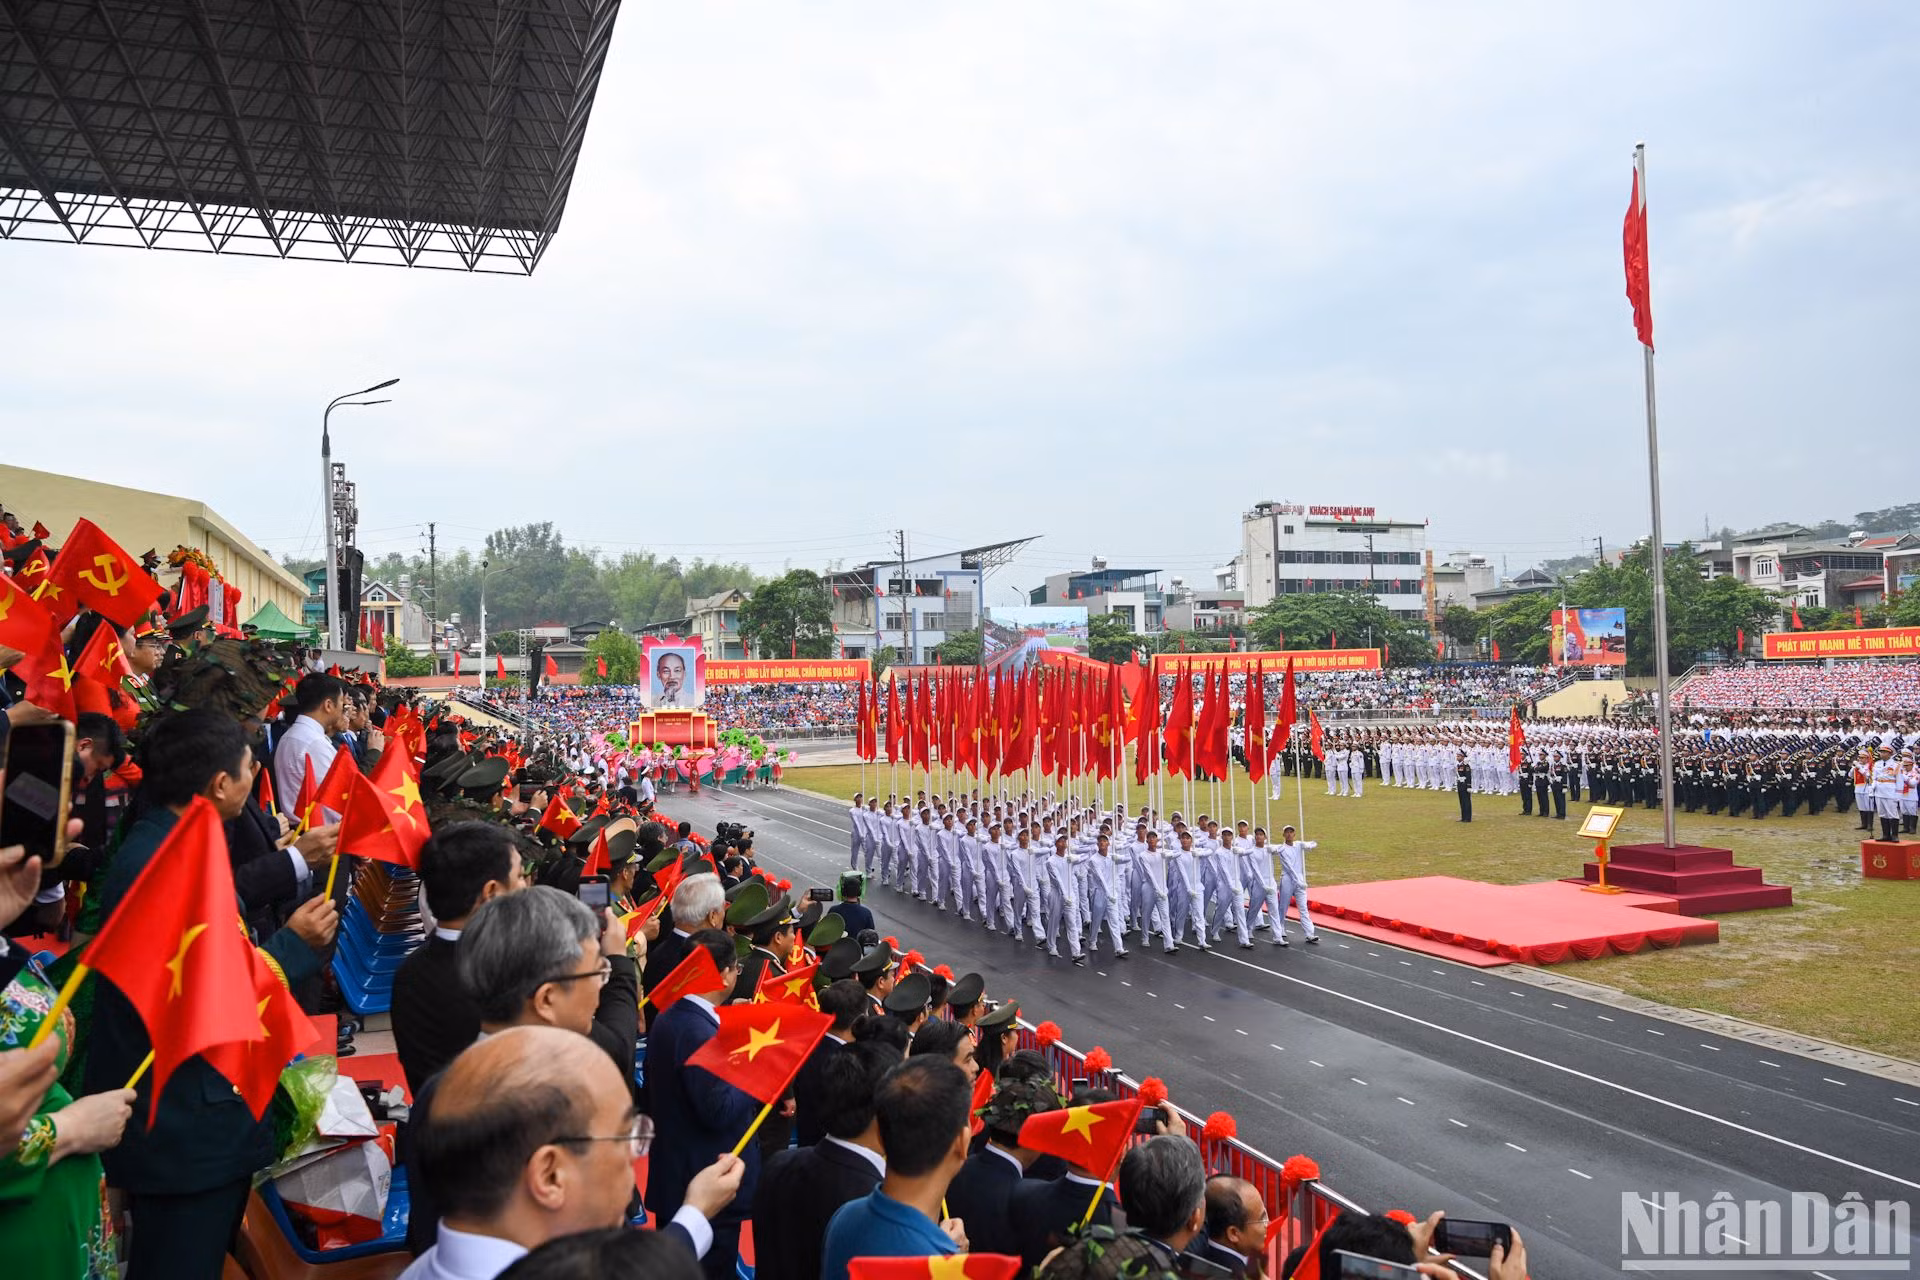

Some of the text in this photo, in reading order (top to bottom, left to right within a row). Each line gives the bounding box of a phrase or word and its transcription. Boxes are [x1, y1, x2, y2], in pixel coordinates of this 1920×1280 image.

[1309, 505, 1329, 516] KHÁCH
[1363, 507, 1375, 517] ANH
[1777, 638, 1797, 652] PHÁT
[1800, 640, 1816, 651] HUY
[1819, 639, 1845, 653] MẠNH
[1848, 636, 1861, 649] MẼ
[1864, 637, 1885, 649] TINH
[1888, 632, 1912, 648] THẦN
[1338, 655, 1348, 666] CHÍ
